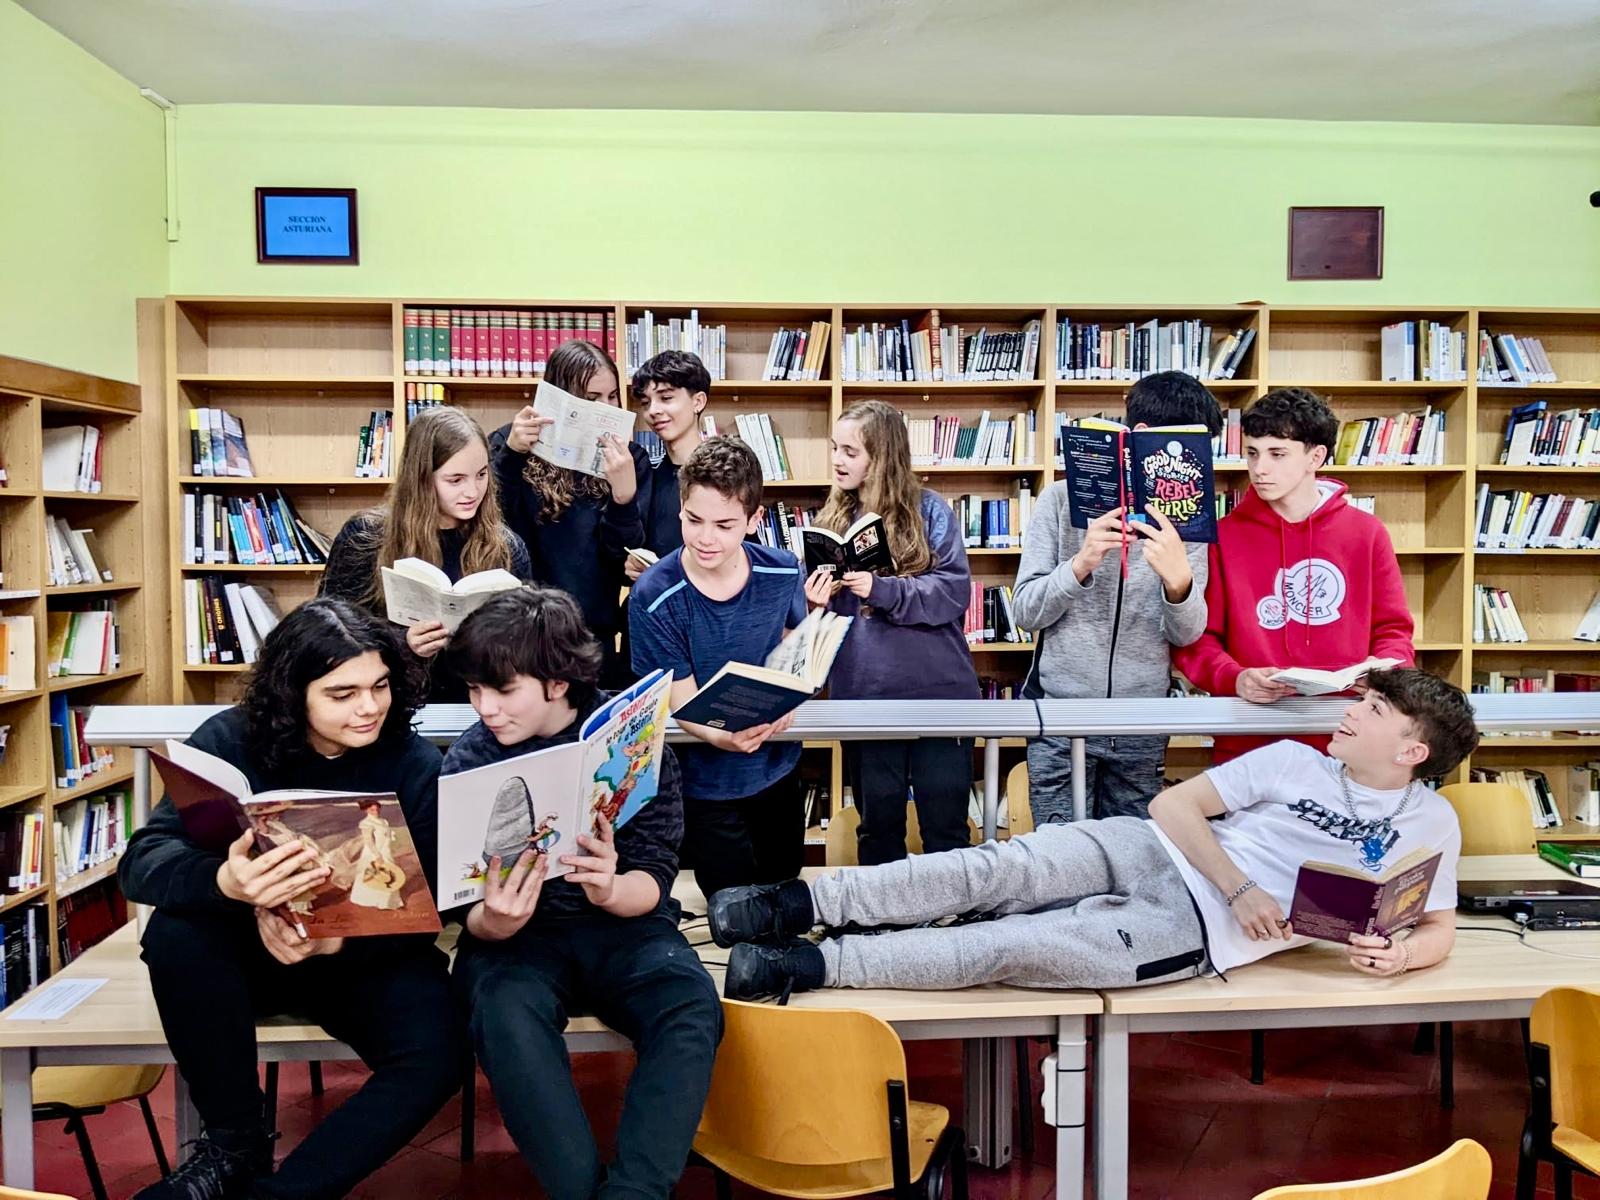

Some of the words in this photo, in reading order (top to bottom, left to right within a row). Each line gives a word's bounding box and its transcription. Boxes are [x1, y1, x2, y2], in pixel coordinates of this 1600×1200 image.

[283, 225, 333, 233] ASTURIANA
[1144, 449, 1169, 478] GOOD
[1165, 456, 1203, 480] NIGHT
[1156, 468, 1190, 482] STORIES
[1155, 478, 1201, 502] REBEL
[1284, 582, 1324, 616] MONCLER
